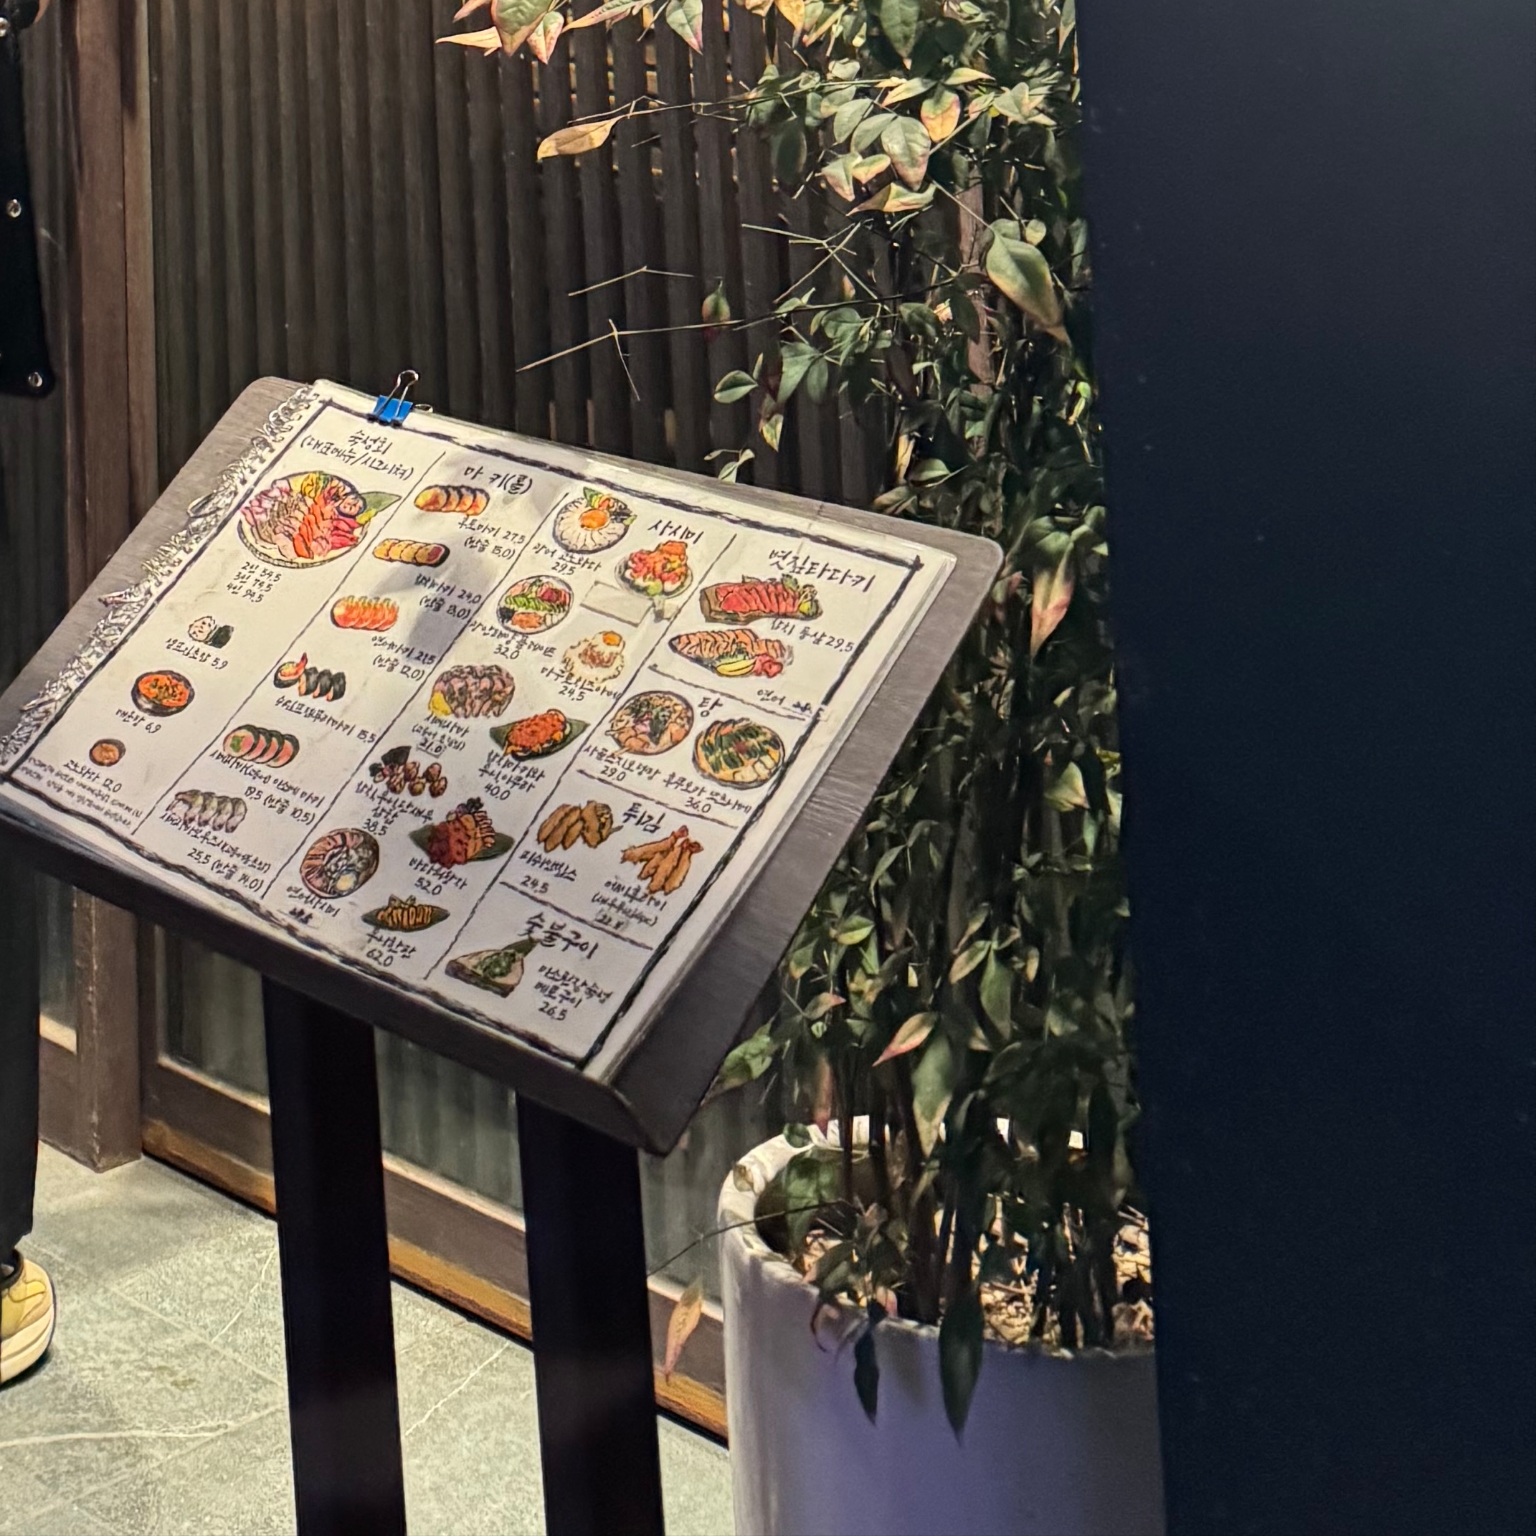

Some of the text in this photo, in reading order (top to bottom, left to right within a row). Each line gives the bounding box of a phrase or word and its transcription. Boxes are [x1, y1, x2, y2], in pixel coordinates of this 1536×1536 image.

[349, 430, 392, 454] 숙성회
[648, 520, 704, 544] 사시미
[698, 696, 723, 718] 탕
[623, 802, 665, 834] 튀김
[518, 912, 599, 959] 숯불구이
